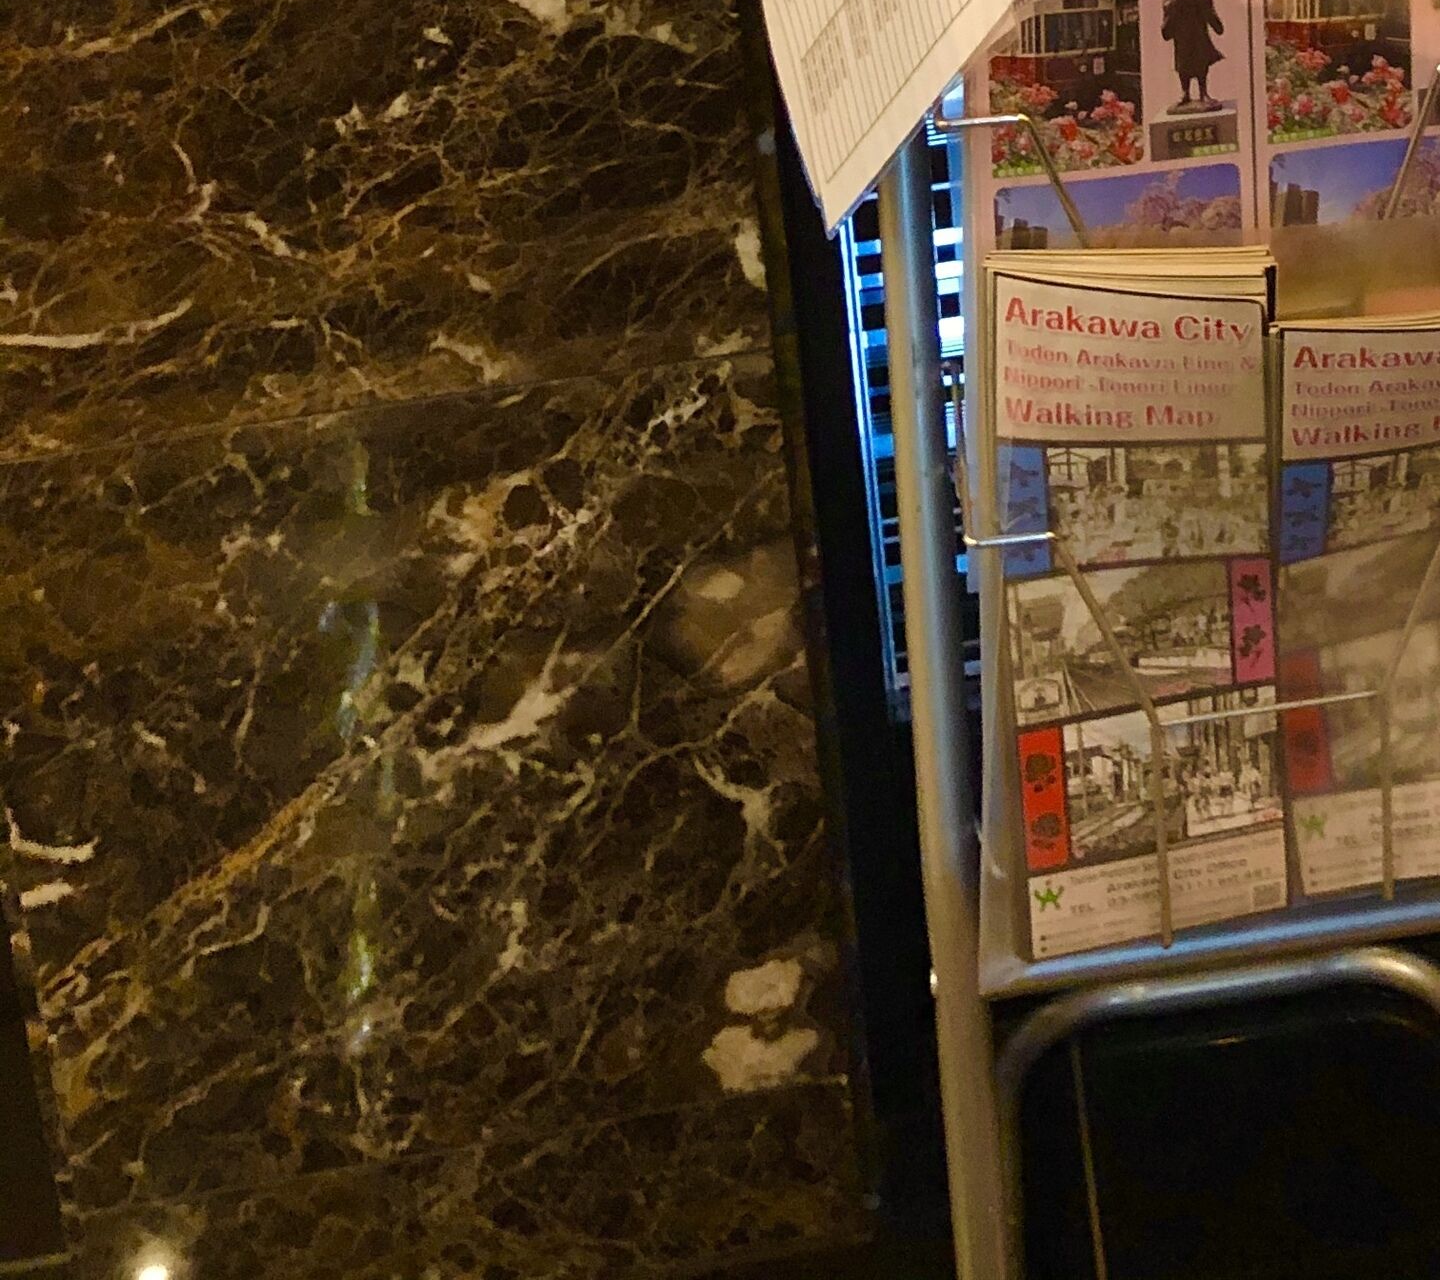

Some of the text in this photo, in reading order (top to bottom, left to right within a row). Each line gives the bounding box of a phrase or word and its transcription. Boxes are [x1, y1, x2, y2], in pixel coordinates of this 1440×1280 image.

[1004, 297, 1255, 345] Arakawa City
[1005, 396, 1216, 429] Walking Map
